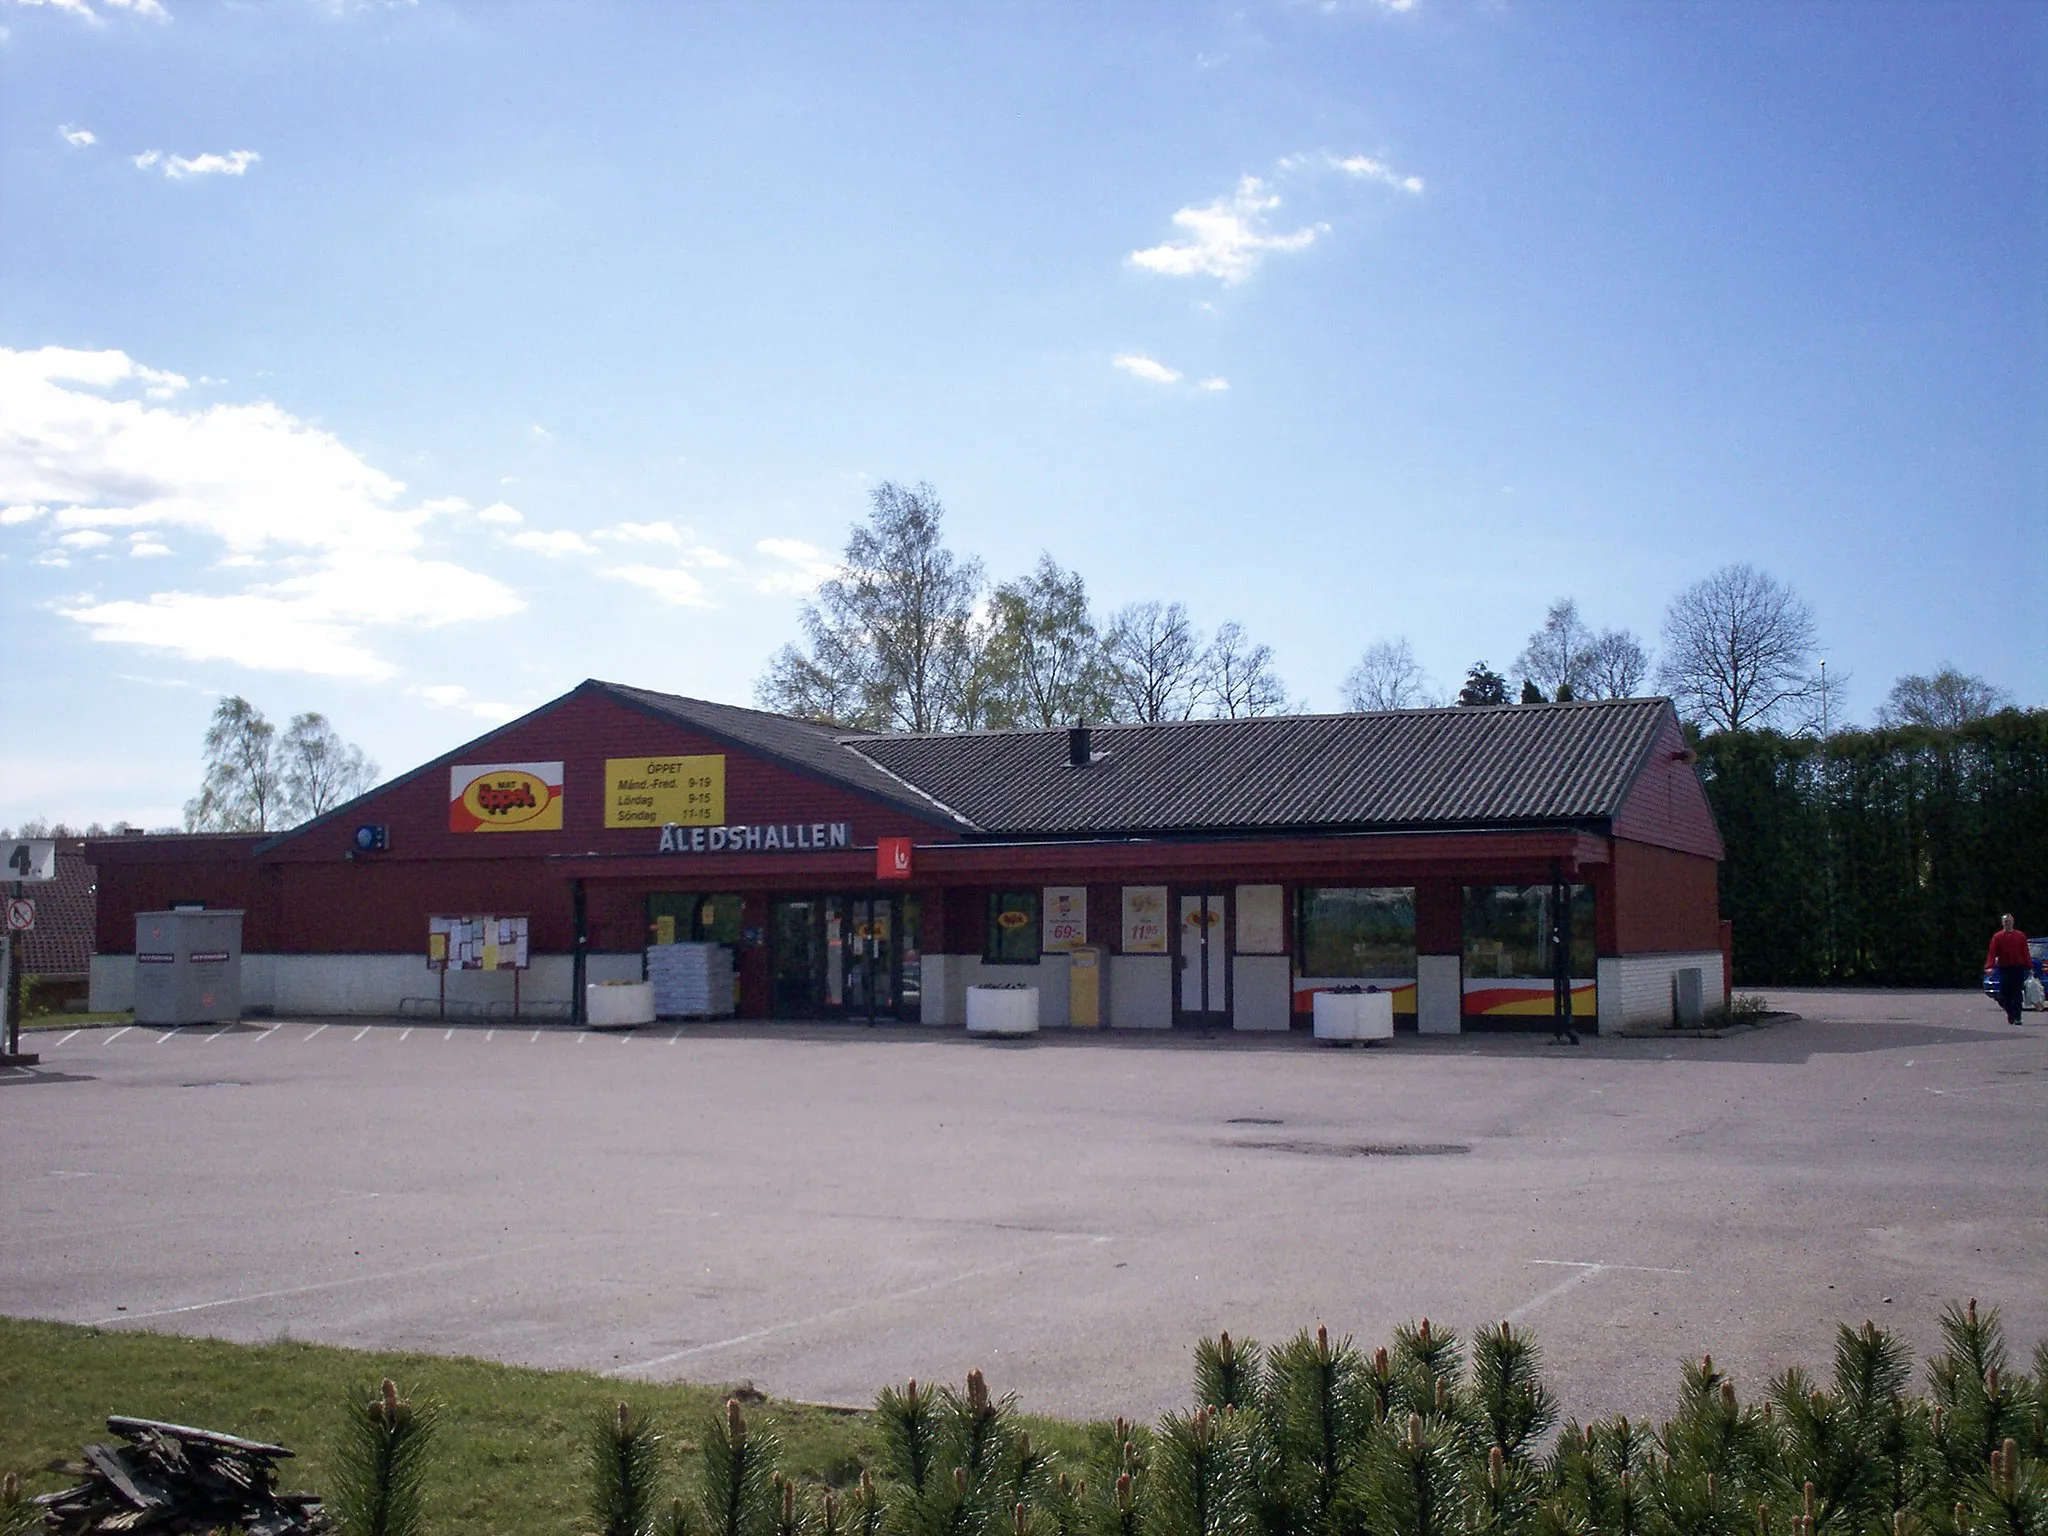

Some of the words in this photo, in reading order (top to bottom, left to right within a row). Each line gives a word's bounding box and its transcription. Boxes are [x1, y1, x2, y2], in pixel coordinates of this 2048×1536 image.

[688, 777, 711, 788] 9-19
[618, 795, 654, 807] Lördag
[688, 793, 711, 804] 9-15
[618, 811, 656, 823] Söndag
[683, 808, 711, 819] 11-15
[659, 823, 846, 851] ÅLEDSHALLEN
[9, 845, 31, 876] 4
